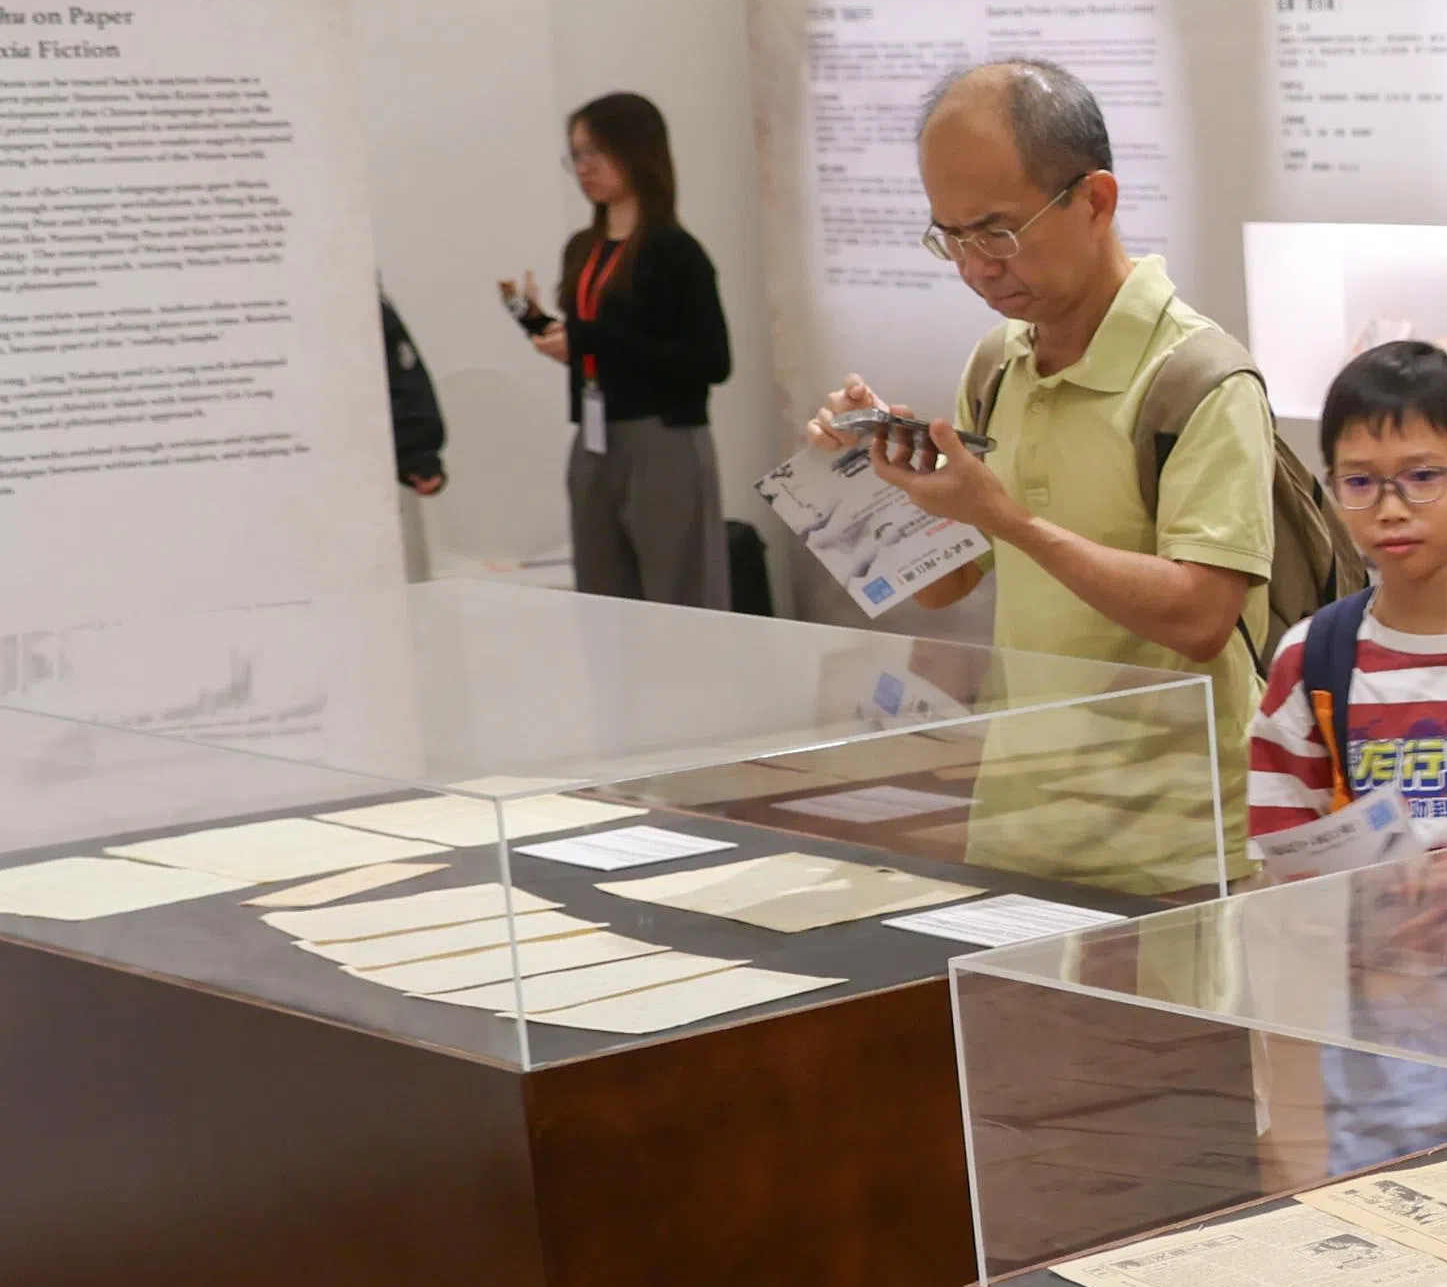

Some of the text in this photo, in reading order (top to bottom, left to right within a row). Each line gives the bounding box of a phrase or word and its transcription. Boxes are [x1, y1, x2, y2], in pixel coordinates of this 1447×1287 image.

[32, 10, 62, 25] on
[68, 6, 134, 30] Paper
[38, 41, 120, 59] Fiction
